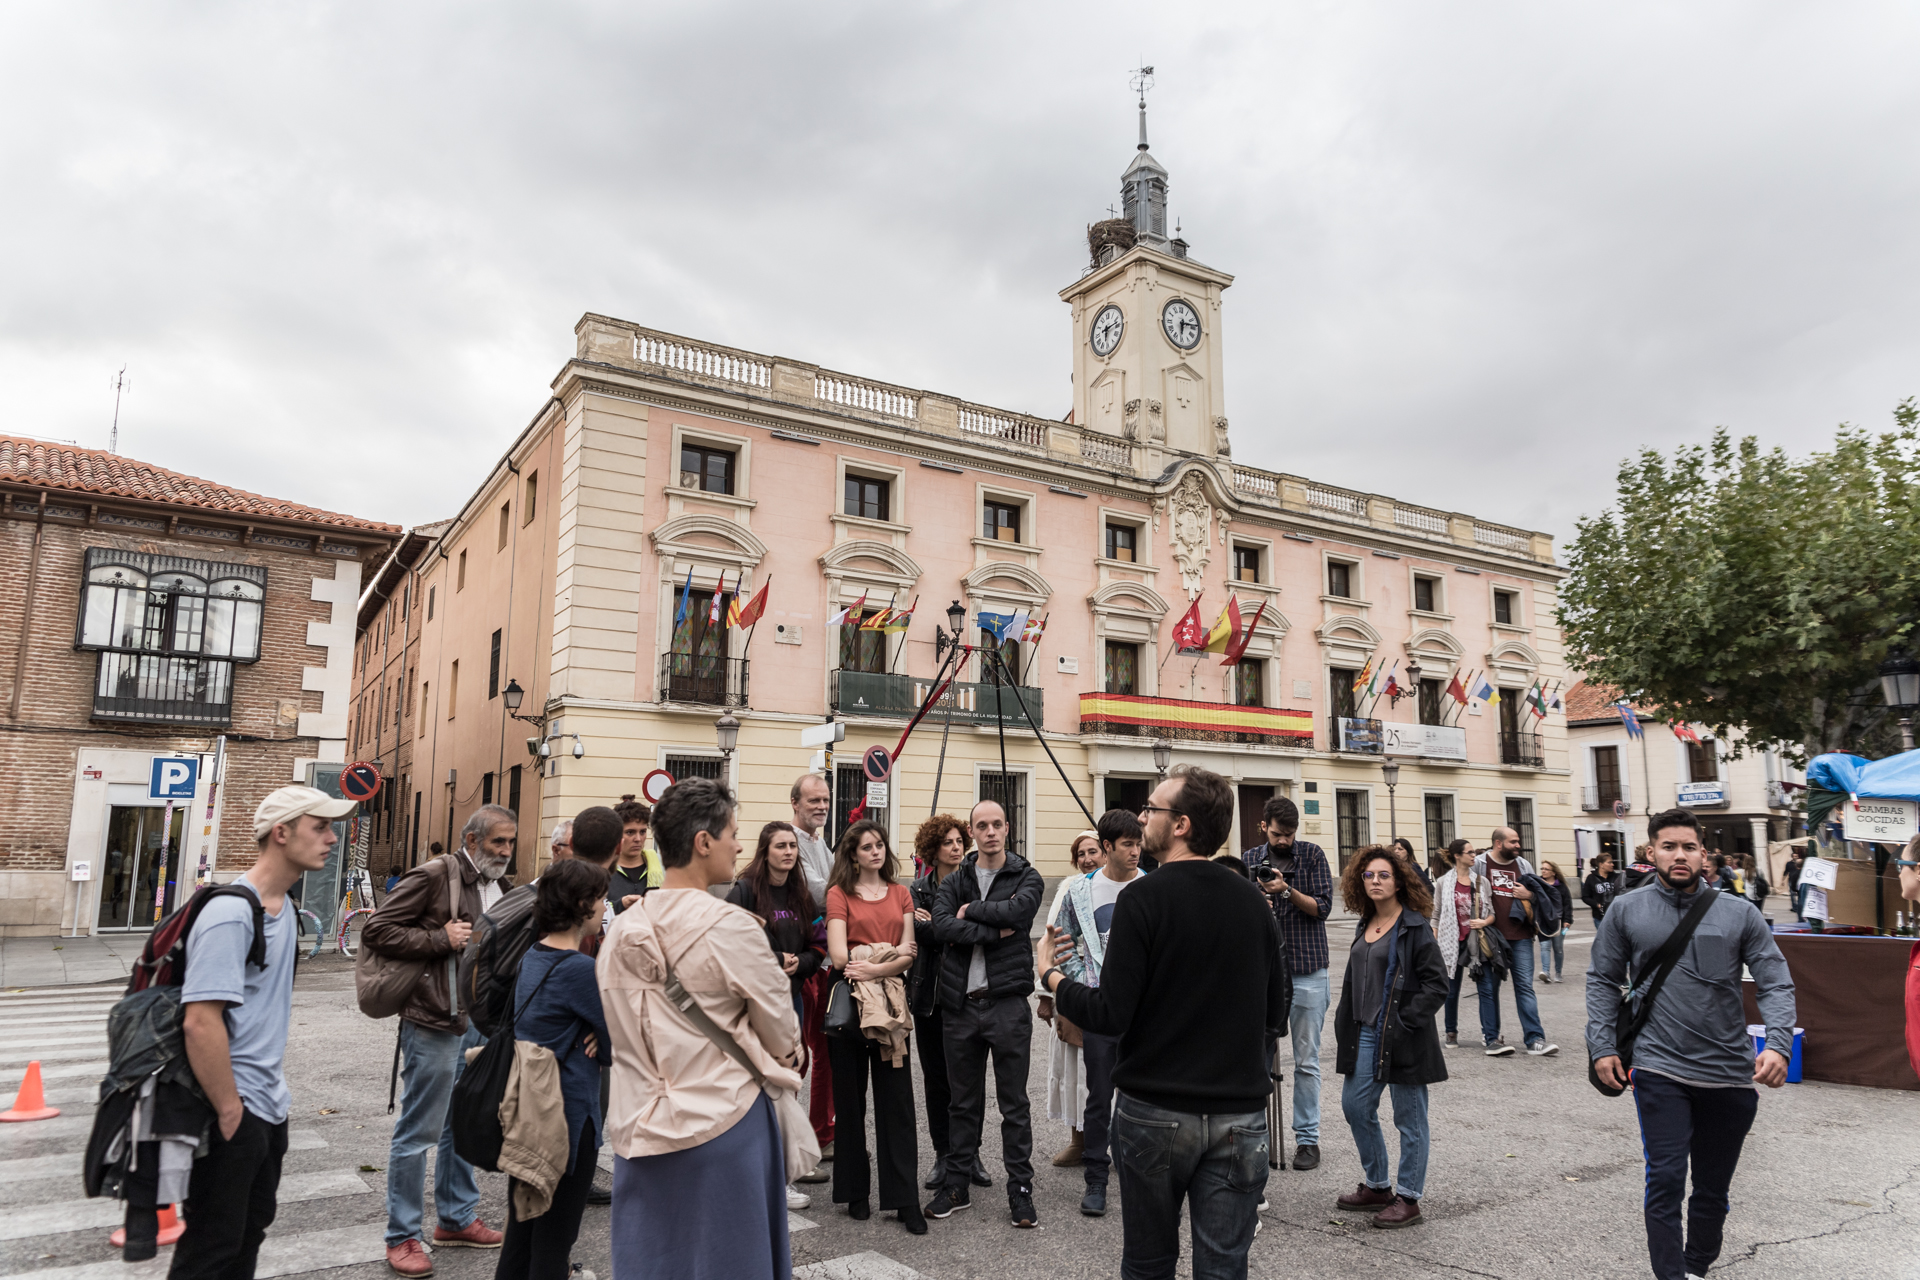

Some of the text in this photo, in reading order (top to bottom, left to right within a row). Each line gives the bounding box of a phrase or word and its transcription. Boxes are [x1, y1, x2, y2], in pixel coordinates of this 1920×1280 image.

[159, 761, 190, 795] P
[1859, 805, 1904, 815] GAMBAS
[1856, 815, 1906, 825] COCIDAS
